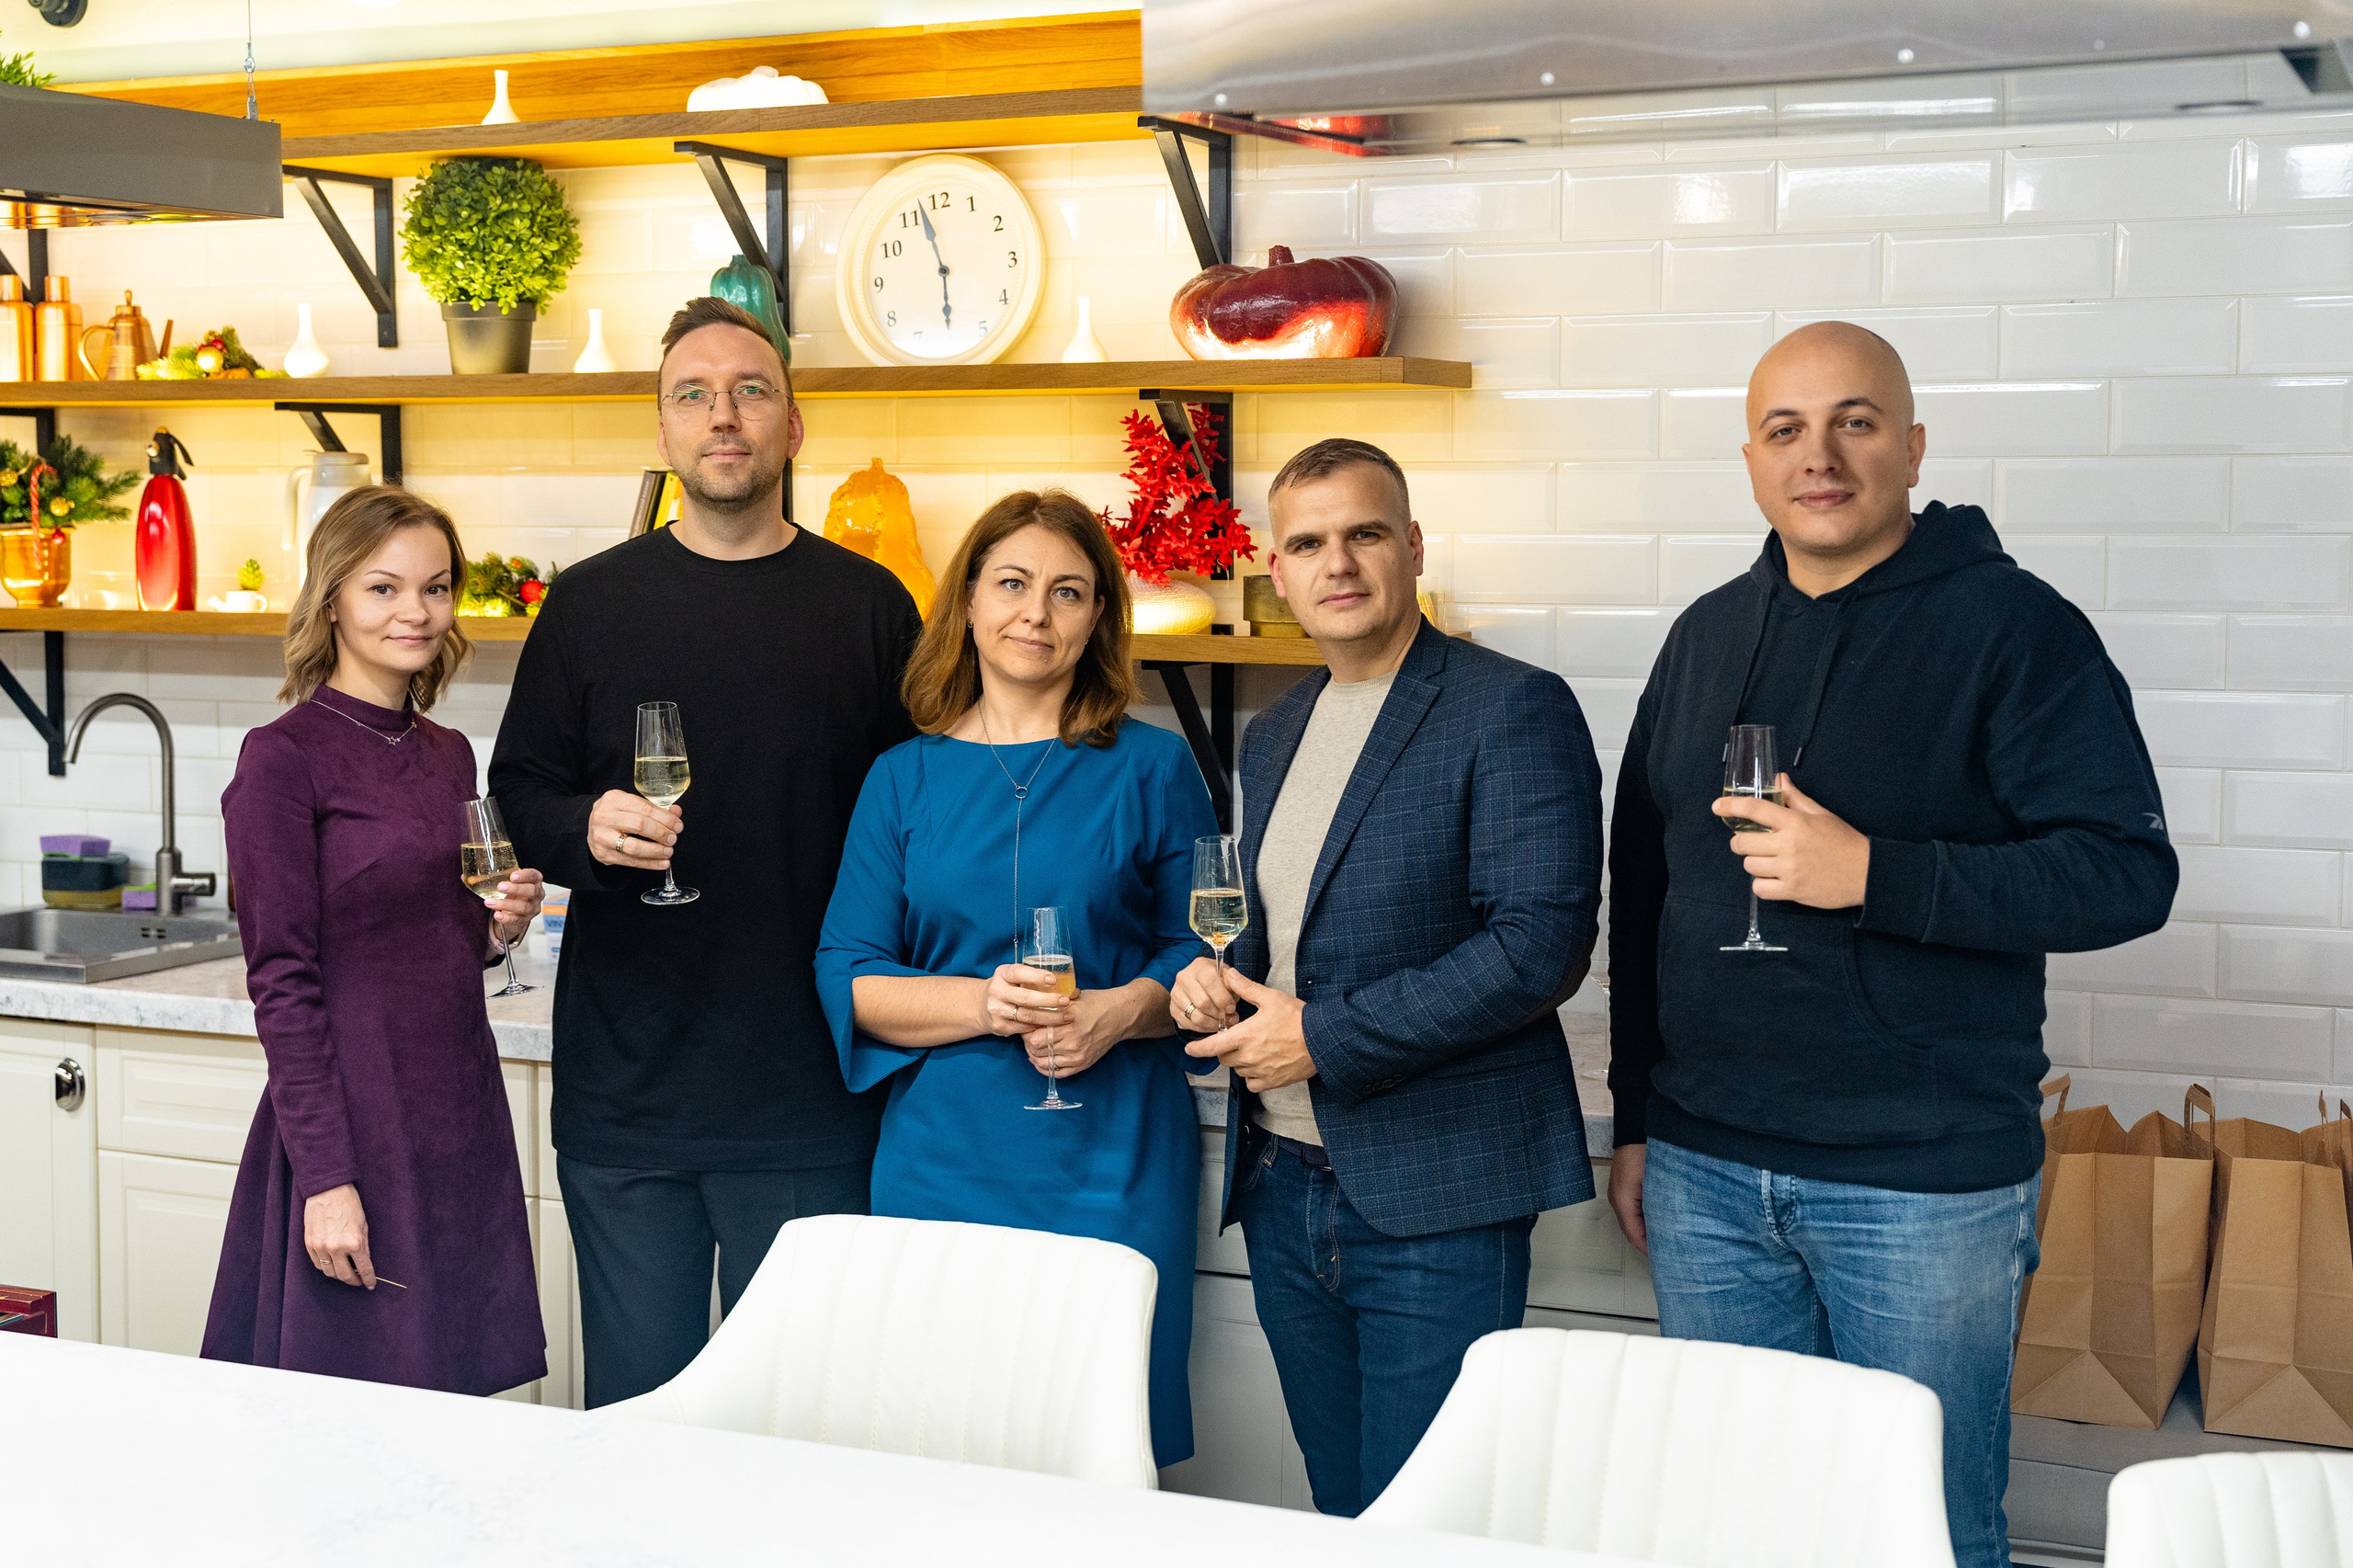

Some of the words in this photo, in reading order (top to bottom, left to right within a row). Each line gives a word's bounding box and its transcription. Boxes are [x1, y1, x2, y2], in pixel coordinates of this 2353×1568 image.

[928, 192, 950, 210] 12
[967, 196, 977, 212] 1
[899, 210, 920, 229] 11
[994, 215, 1004, 232] 2
[881, 240, 902, 258] 10
[1007, 252, 1017, 267] 3
[874, 277, 883, 293] 9
[999, 290, 1008, 305] 4
[887, 311, 896, 326] 8
[978, 321, 988, 336] 5
